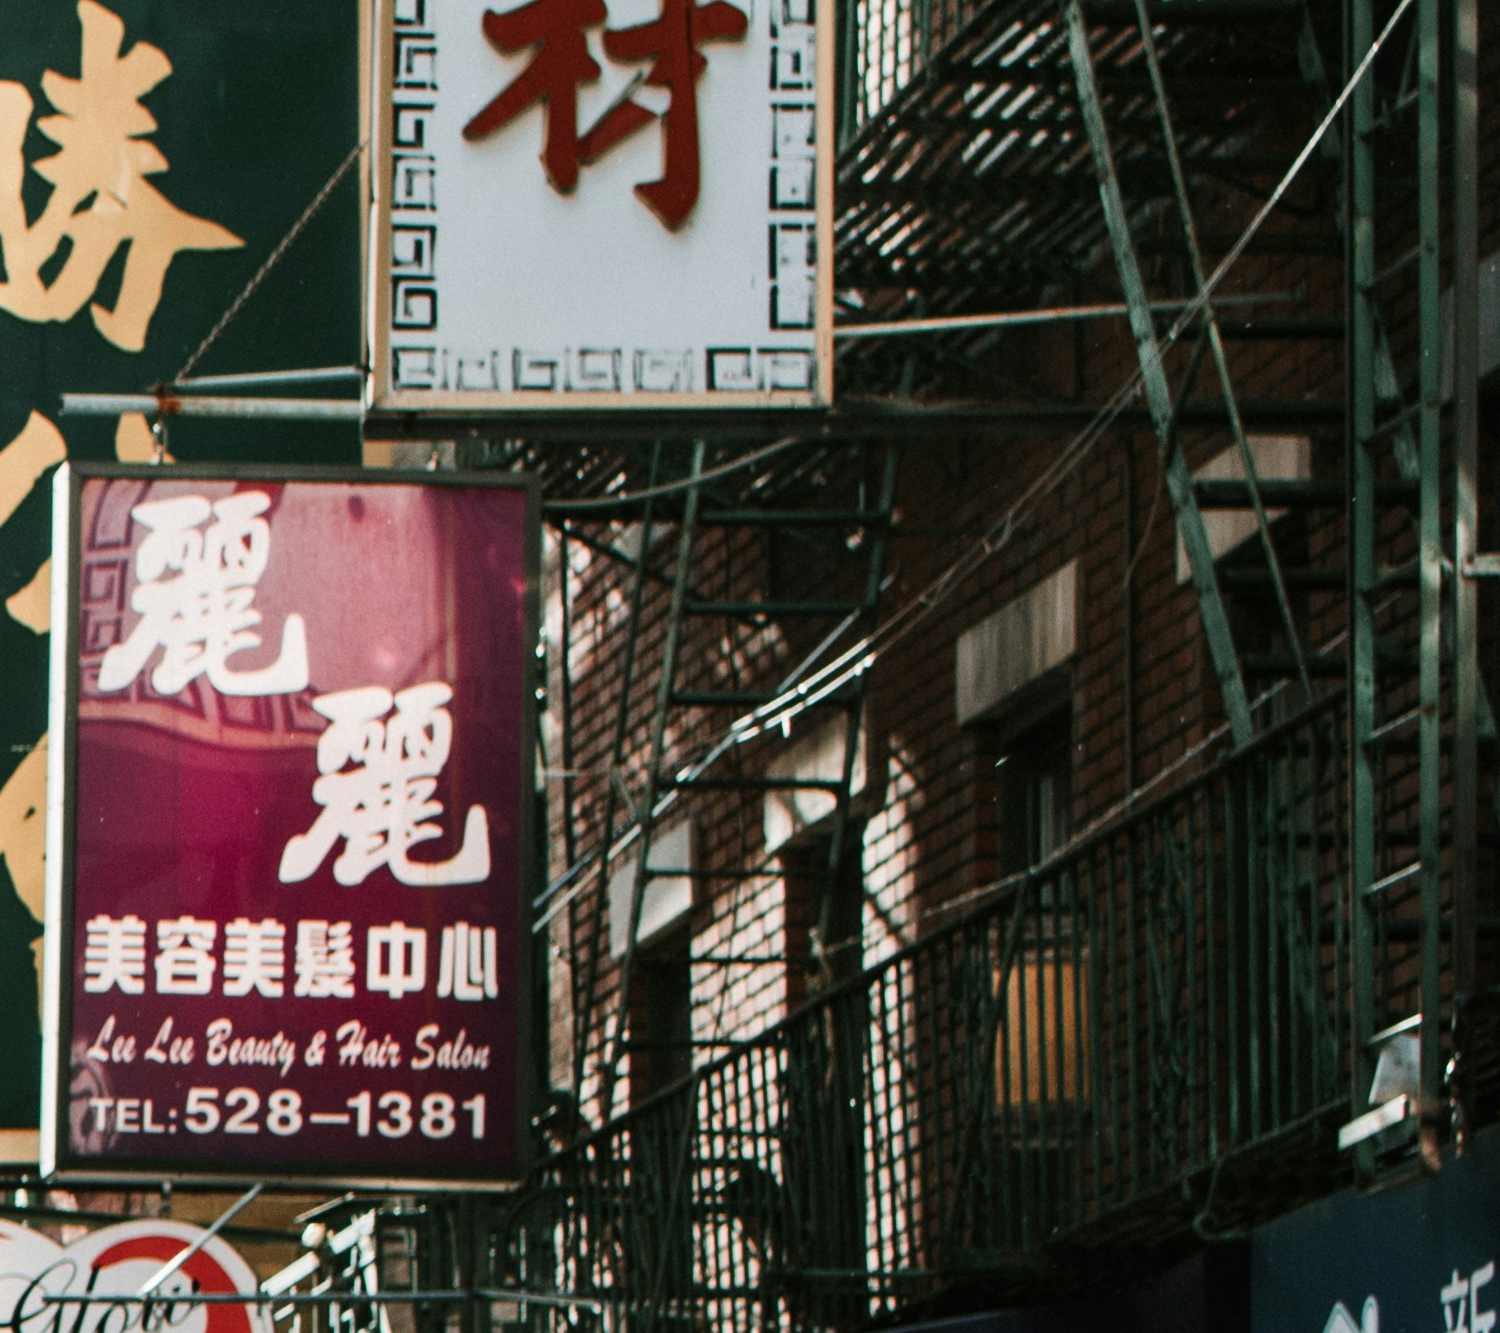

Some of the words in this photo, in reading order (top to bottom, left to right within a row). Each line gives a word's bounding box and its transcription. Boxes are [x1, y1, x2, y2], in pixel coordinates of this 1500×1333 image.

[83, 917, 499, 1001] 美容美髮中心
[87, 1014, 137, 1064] Lee
[144, 1015, 195, 1065] Lee
[206, 1017, 297, 1078] Beauty
[304, 1030, 327, 1067] &
[336, 1019, 401, 1070] Hair
[410, 1023, 491, 1071] Salon
